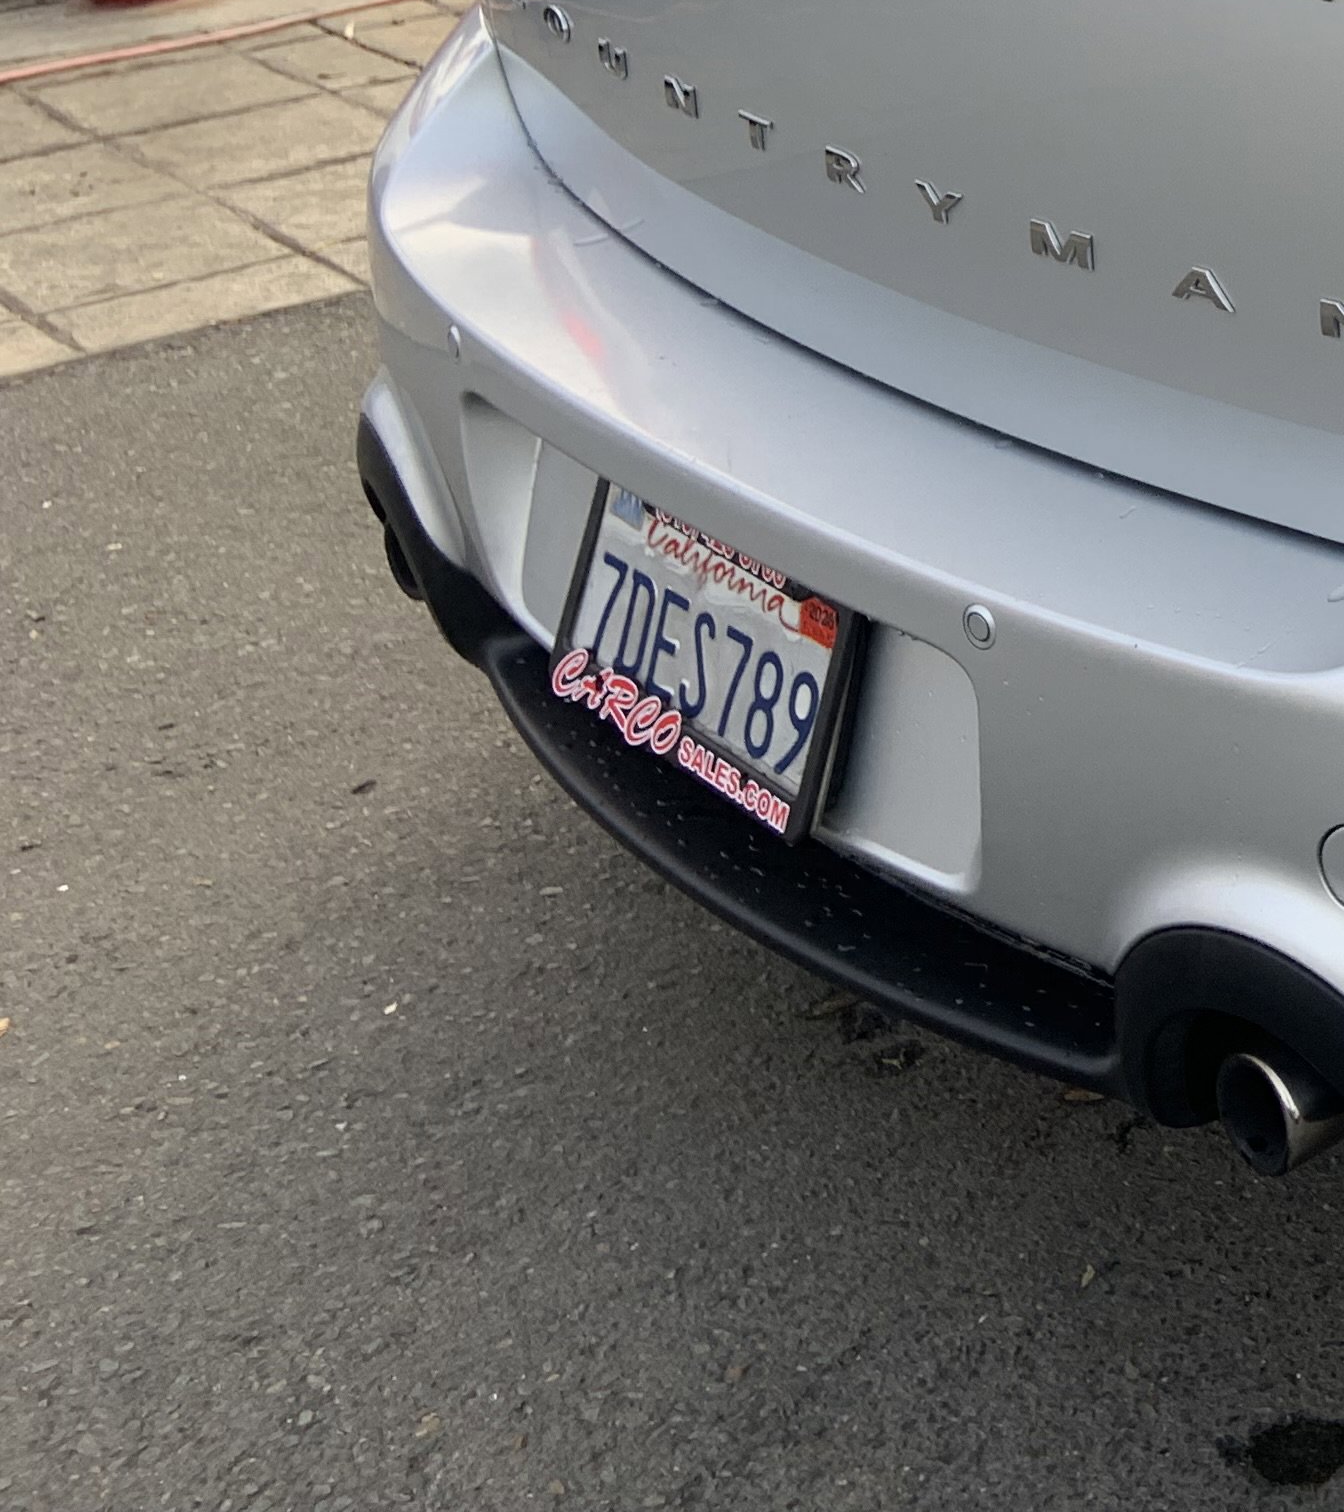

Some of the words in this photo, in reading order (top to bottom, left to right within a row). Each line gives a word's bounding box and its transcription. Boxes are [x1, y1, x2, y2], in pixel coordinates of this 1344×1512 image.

[593, 551, 820, 774] 7DES789
[643, 514, 802, 633] California
[551, 648, 683, 755] CARCO
[677, 735, 791, 834] SALES.COM
